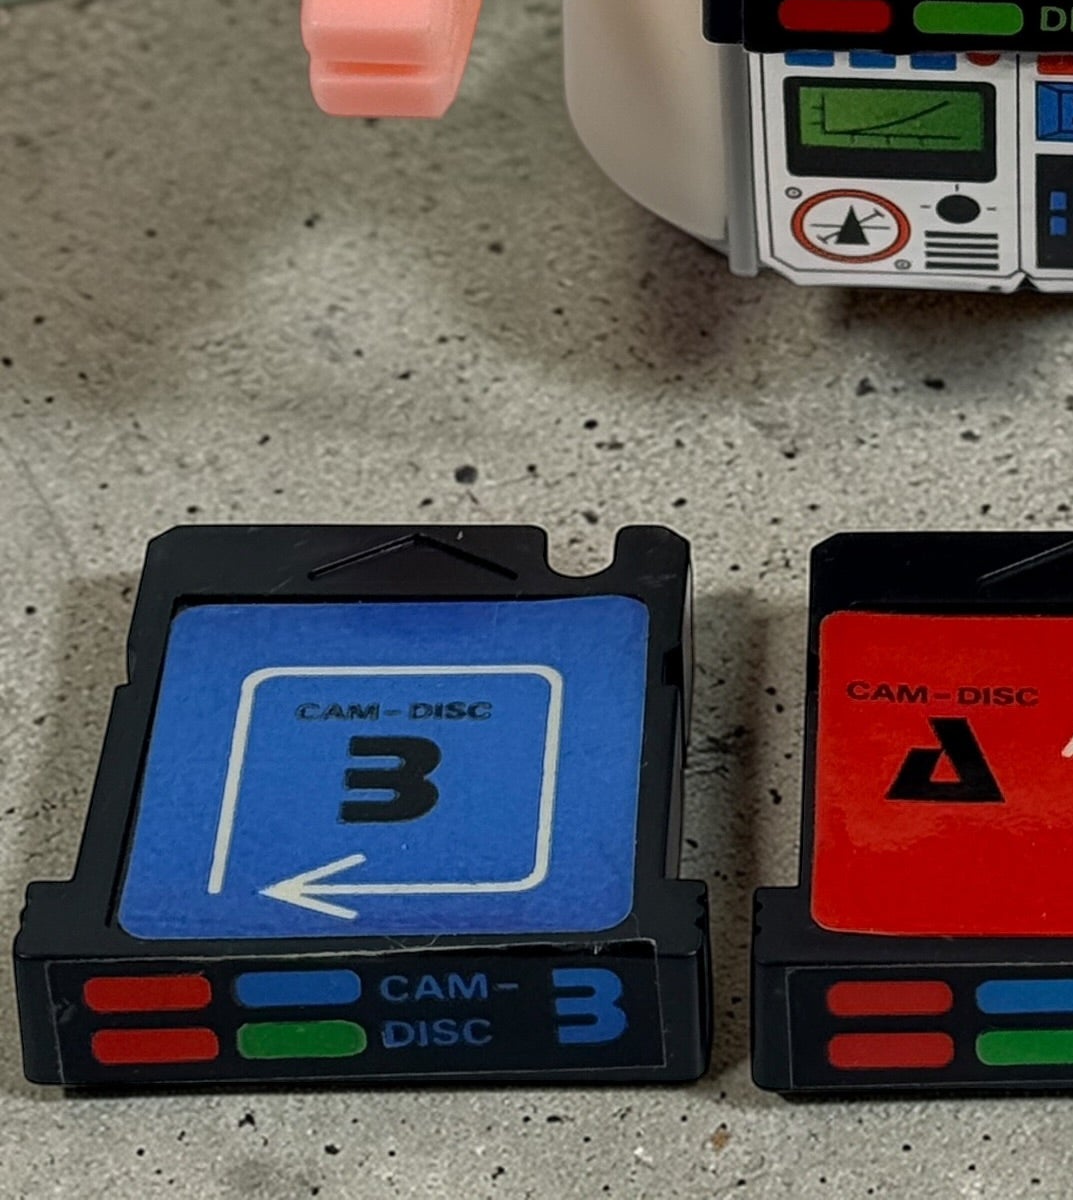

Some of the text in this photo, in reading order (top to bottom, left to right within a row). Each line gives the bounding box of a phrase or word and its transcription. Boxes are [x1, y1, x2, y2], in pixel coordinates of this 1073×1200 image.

[883, 716, 1007, 804] A
[378, 974, 520, 1002] CAM-
[381, 1018, 493, 1050] DISC
